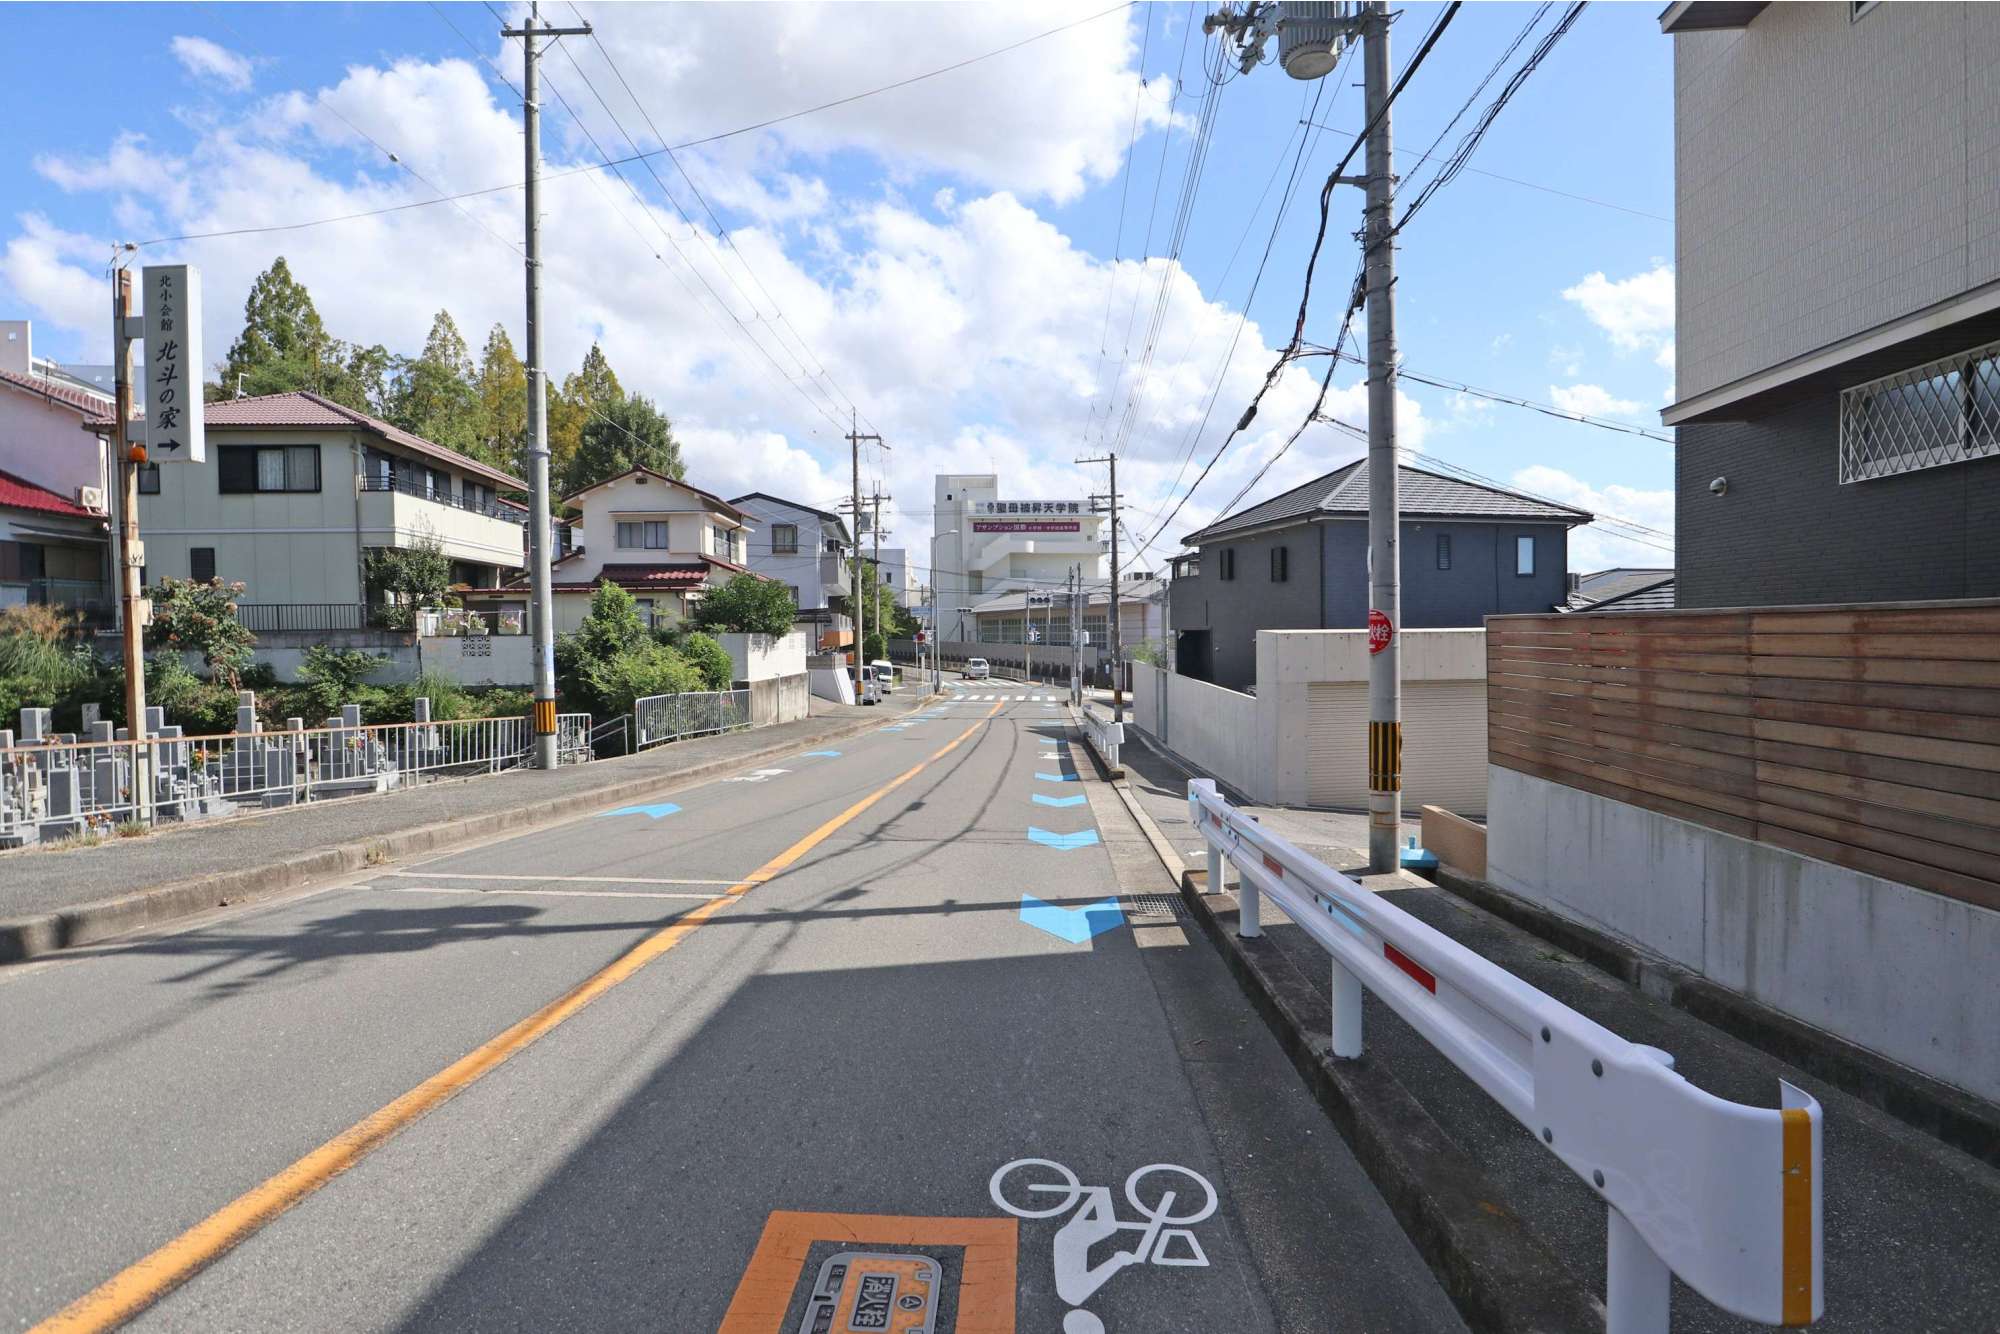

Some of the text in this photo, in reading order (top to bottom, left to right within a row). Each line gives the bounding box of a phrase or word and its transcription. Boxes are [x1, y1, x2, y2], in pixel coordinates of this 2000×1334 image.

[160, 275, 173, 332] 北小会館
[156, 340, 181, 430] 北斗の家
[855, 1278, 892, 1326] 消火栓
